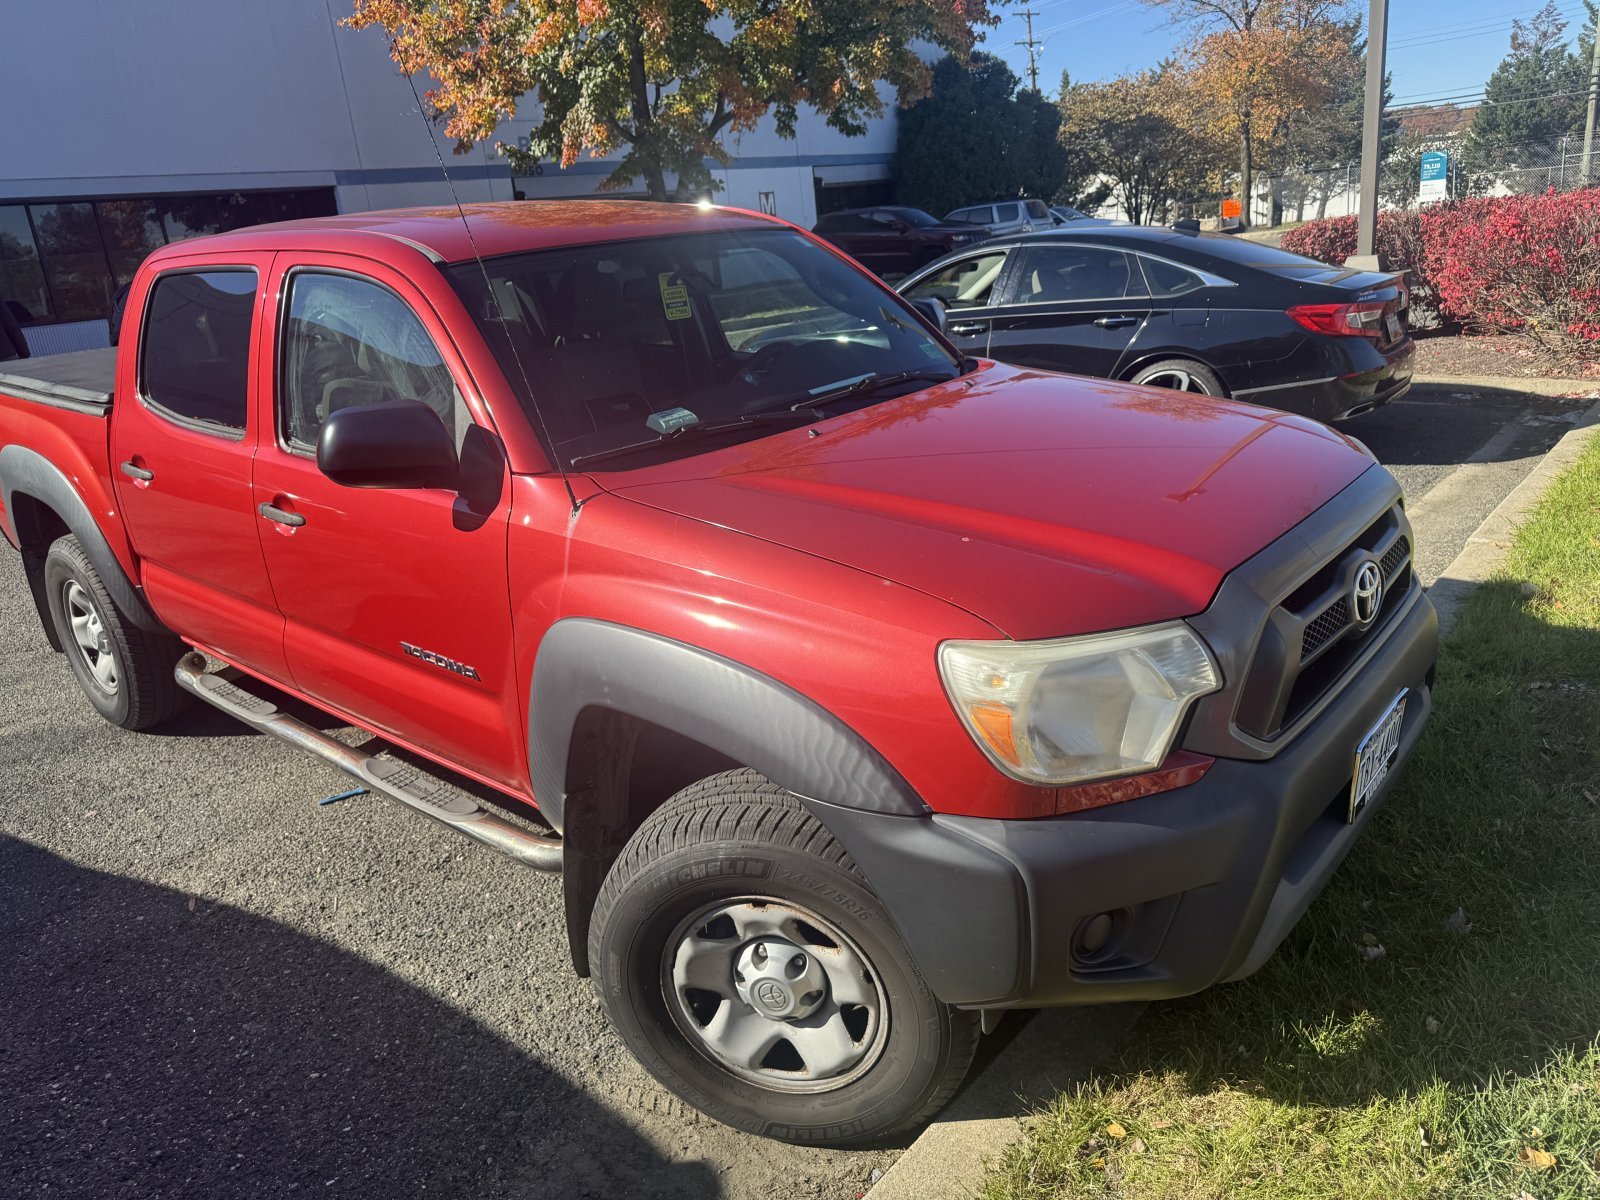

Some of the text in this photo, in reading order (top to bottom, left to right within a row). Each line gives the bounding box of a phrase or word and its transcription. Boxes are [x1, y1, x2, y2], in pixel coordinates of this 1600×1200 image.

[400, 641, 481, 682] TACOMA
[653, 861, 766, 890] MICHELIN
[769, 1112, 879, 1140] MICHELIN
